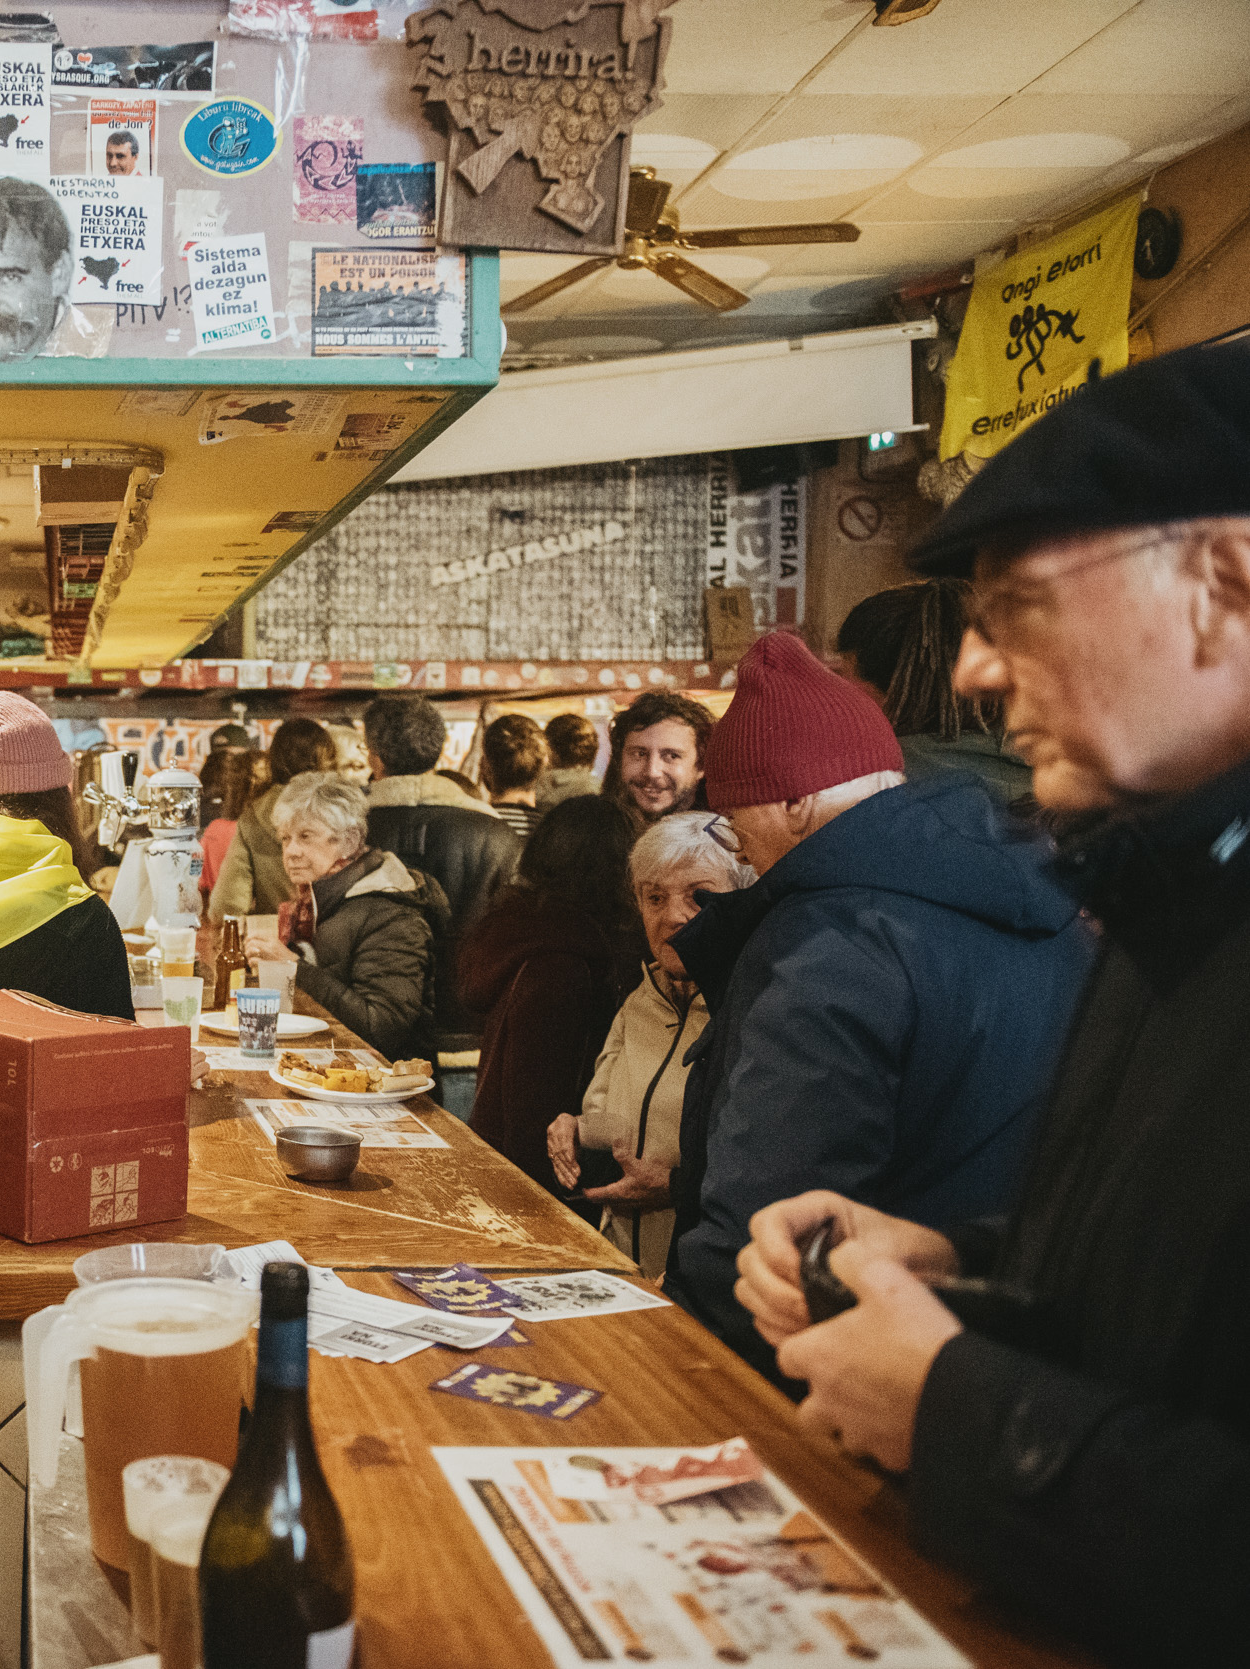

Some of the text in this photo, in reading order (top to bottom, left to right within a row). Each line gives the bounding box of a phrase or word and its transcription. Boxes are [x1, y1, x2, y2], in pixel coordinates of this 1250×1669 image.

[466, 28, 635, 80] herrira!
[22, 75, 44, 83] ETA
[197, 102, 263, 122] Liburu libreak
[108, 119, 121, 129] de
[124, 119, 143, 129] Jon
[15, 136, 44, 149] free
[56, 188, 119, 199] LORENTXO
[81, 204, 148, 219] EUSKAL
[80, 217, 146, 228] PRESO ETA
[80, 226, 146, 236] IHESLARIAK
[80, 235, 146, 250] ETXERA
[194, 247, 261, 263] Sistema
[332, 255, 349, 266] LE
[1046, 236, 1102, 283] etorri
[211, 260, 247, 275] alda
[340, 268, 365, 278] EST
[369, 268, 386, 279] UN
[116, 279, 144, 293] free
[194, 273, 267, 291] dezagun
[222, 290, 243, 301] ez
[206, 300, 259, 316] klima!
[203, 316, 268, 343] ALTERNATIBA
[315, 333, 345, 345] NOUS
[347, 333, 393, 345] SOMMES
[431, 521, 625, 587] ASKATASUNA
